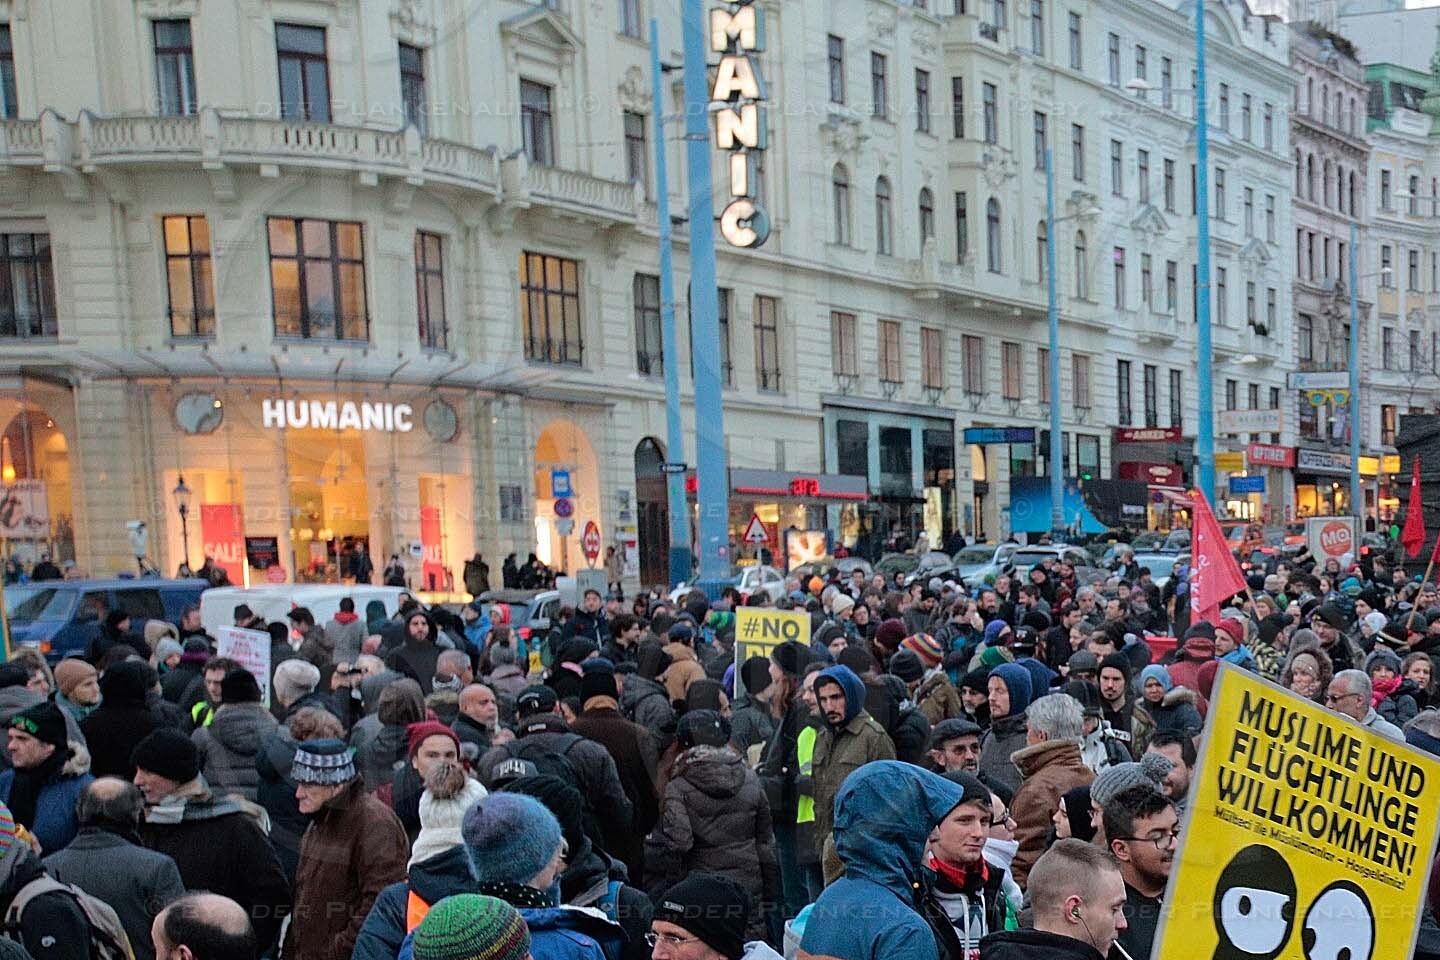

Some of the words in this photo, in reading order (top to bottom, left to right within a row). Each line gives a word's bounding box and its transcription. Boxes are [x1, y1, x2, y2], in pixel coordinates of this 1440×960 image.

[709, 0, 770, 248] MANIC
[262, 399, 413, 432] HUMANIC
[792, 478, 821, 496] ara
[204, 542, 243, 563] SALE
[742, 617, 801, 640] #NO
[1238, 690, 1362, 773] MUSLIME
[1367, 746, 1426, 799] UND
[1229, 728, 1420, 838] FLÜCHTLINGE
[1217, 765, 1418, 876] WILLKOMMEN!
